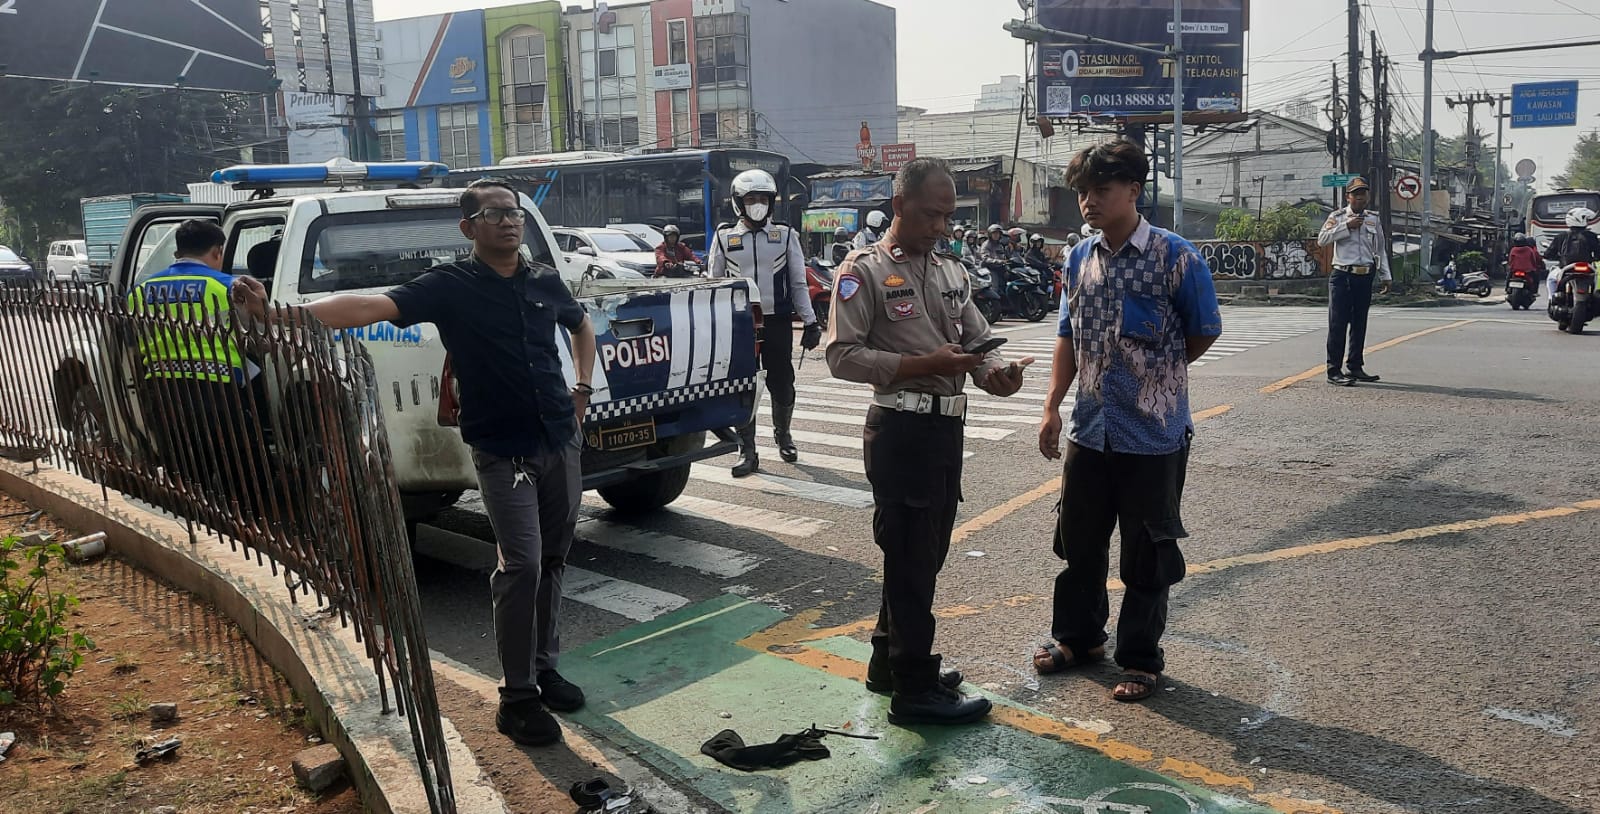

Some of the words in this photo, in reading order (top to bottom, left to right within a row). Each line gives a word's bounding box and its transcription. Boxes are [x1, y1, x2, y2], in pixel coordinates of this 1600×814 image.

[1080, 54, 1121, 65] STASIUN
[1122, 54, 1141, 65] KRL
[1185, 54, 1204, 65] EXIT
[1206, 54, 1223, 65] TOL
[1185, 68, 1218, 79] TELAGA
[1219, 67, 1240, 78] ASIH
[1093, 94, 1122, 107] 0813
[1124, 94, 1155, 107] 8888
[1526, 100, 1562, 110] KAWASAN
[1537, 112, 1553, 121] LALU
[601, 335, 671, 372] POLISI
